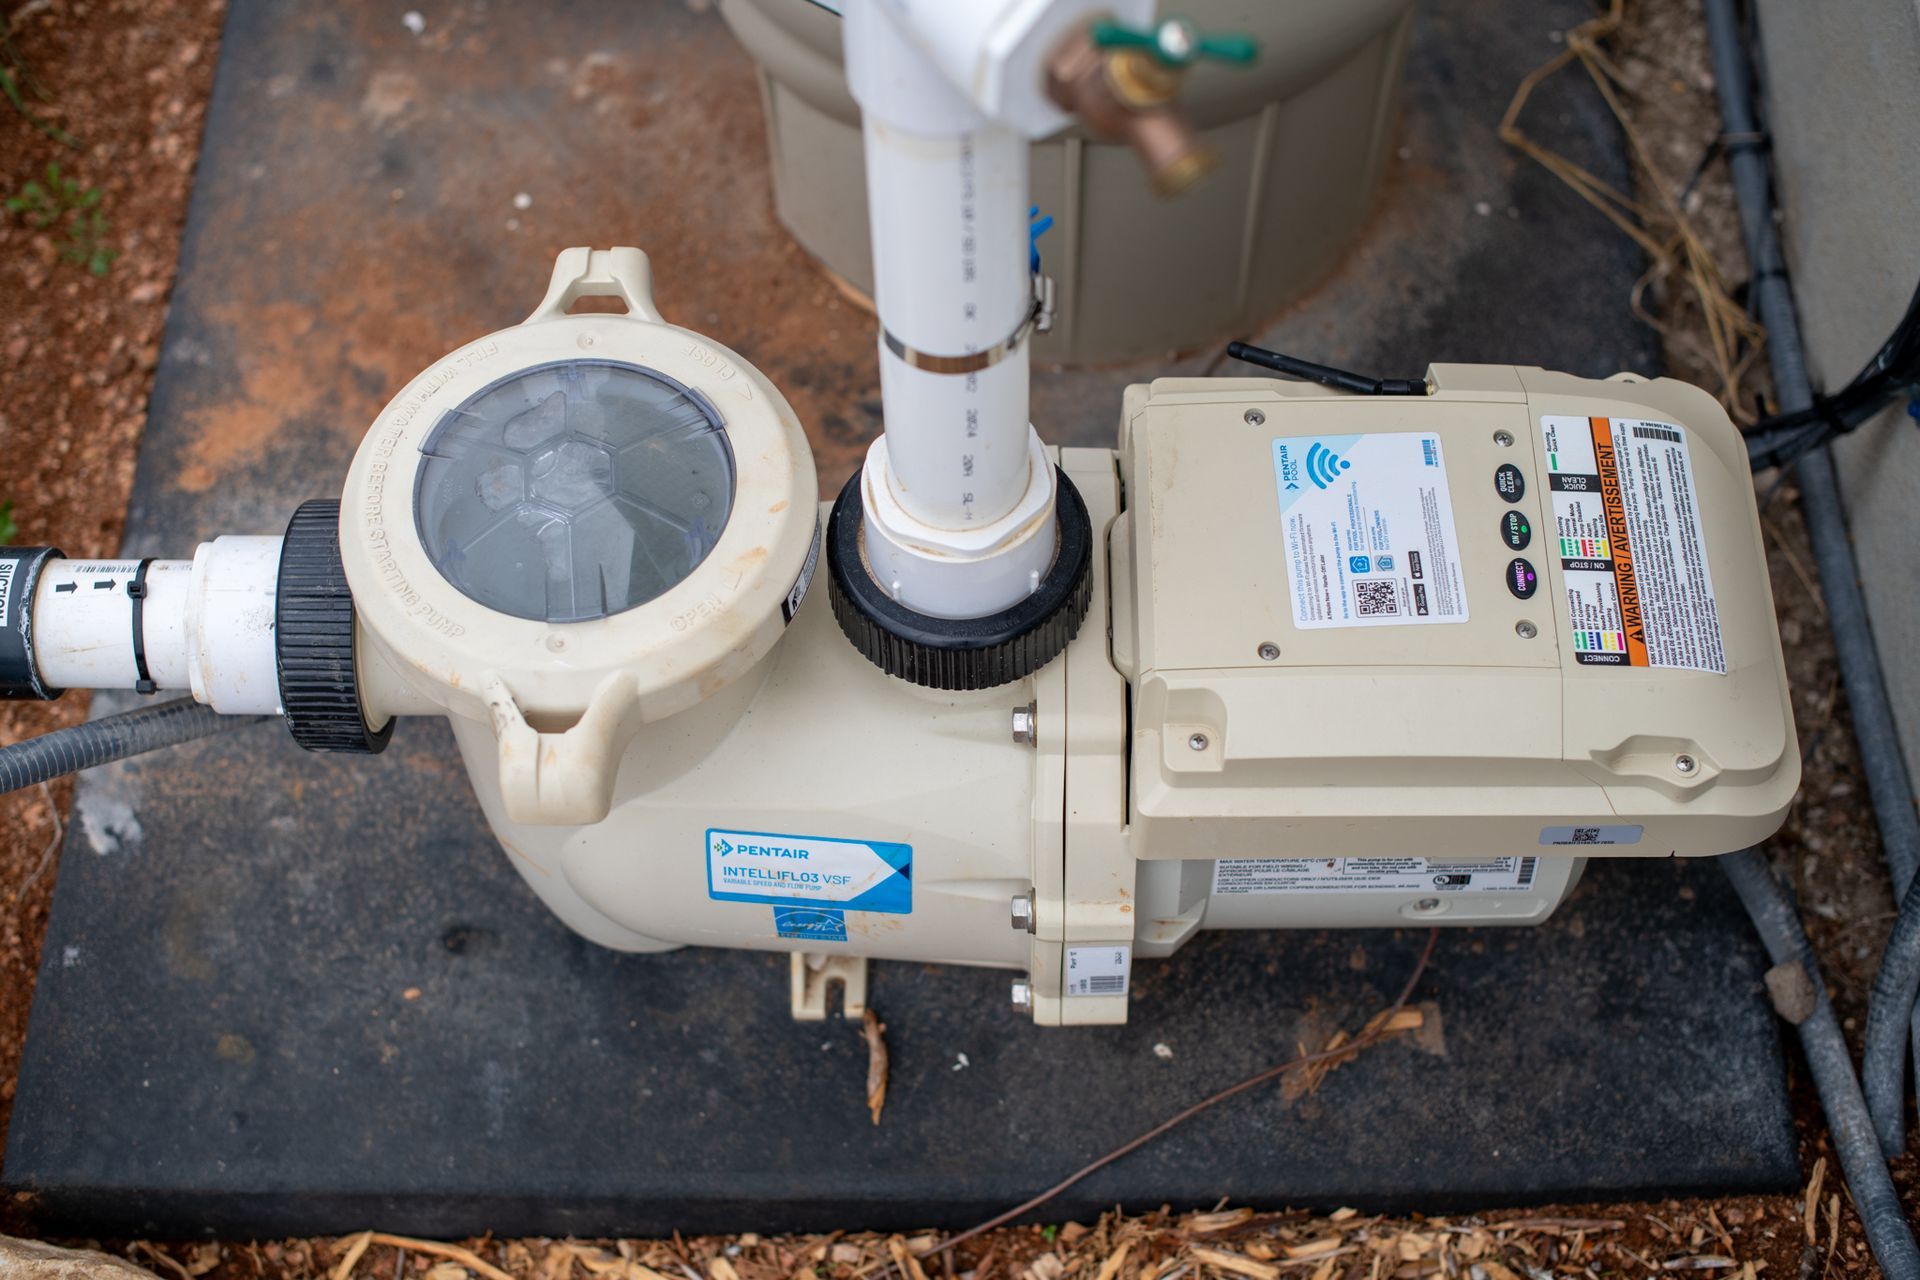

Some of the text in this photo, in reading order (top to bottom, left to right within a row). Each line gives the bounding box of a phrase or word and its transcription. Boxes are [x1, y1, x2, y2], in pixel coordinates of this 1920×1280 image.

[687, 342, 736, 380] CLOSE
[375, 401, 421, 458] WATER
[1545, 432, 1553, 452] Running
[1280, 445, 1291, 481] PENTAIR
[1290, 459, 1299, 480] POOL
[1498, 472, 1508, 492] QUICK
[1506, 471, 1515, 493] CLEAN
[366, 461, 388, 526] BEFORE
[1598, 443, 1629, 552] AVERTISSEMENT
[1347, 494, 1356, 529] PROFESSIONALS
[1508, 513, 1518, 530] STOP
[1288, 515, 1297, 531] now.
[1564, 518, 1572, 537] Priming
[1592, 518, 1600, 538] Warning
[1290, 532, 1299, 550] Wi-Fi
[1512, 536, 1520, 544] ON
[370, 527, 422, 607] STARTING
[1294, 560, 1304, 578] pump
[1514, 561, 1527, 591] CONNECT
[1296, 579, 1304, 592] this
[1617, 562, 1642, 628] WARNING
[1297, 593, 1308, 621] Connect
[1568, 589, 1577, 617] Connecting
[1575, 590, 1584, 617] Connected
[1595, 583, 1604, 613] Provisioning
[416, 602, 466, 638] PUMP
[670, 591, 722, 632] OPEN
[1584, 604, 1592, 621] Pairing
[1606, 607, 1614, 631] Updating
[1612, 602, 1621, 630] Automation
[1594, 622, 1599, 630] BT
[1583, 653, 1620, 663] CONNECT
[737, 845, 809, 859] PENTAIR
[723, 866, 851, 885] INTELLIFLO3 VSF
[723, 878, 751, 886] VARIABLE
